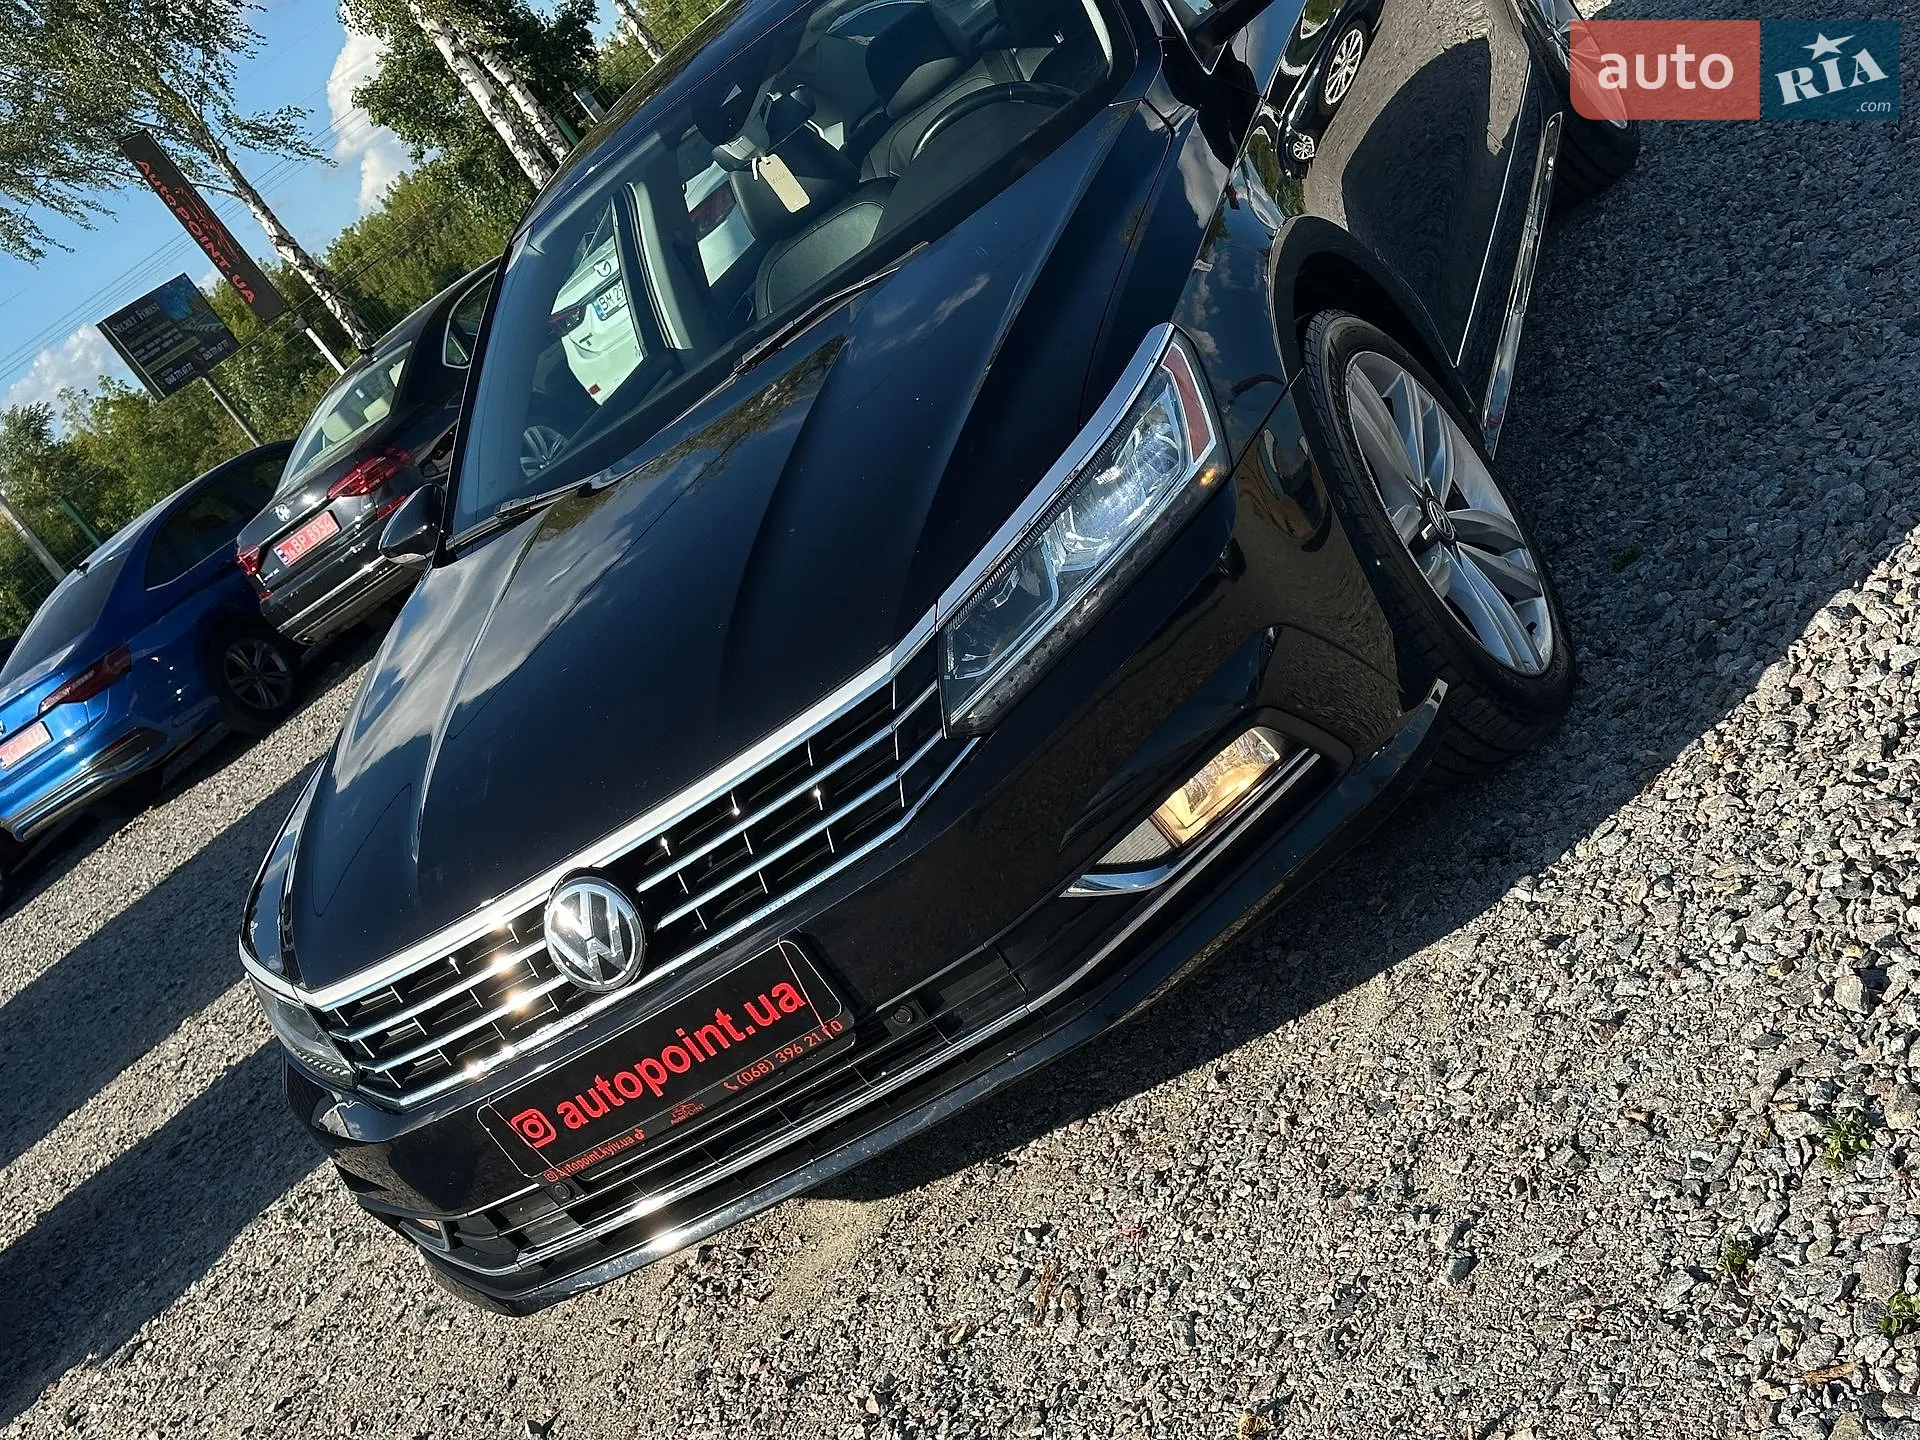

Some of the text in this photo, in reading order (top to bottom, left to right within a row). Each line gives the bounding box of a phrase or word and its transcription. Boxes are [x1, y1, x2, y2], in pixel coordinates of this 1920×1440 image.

[557, 982, 806, 1130] autopoint.ua
[737, 1060, 775, 1087] (068)
[775, 1043, 804, 1063] 396
